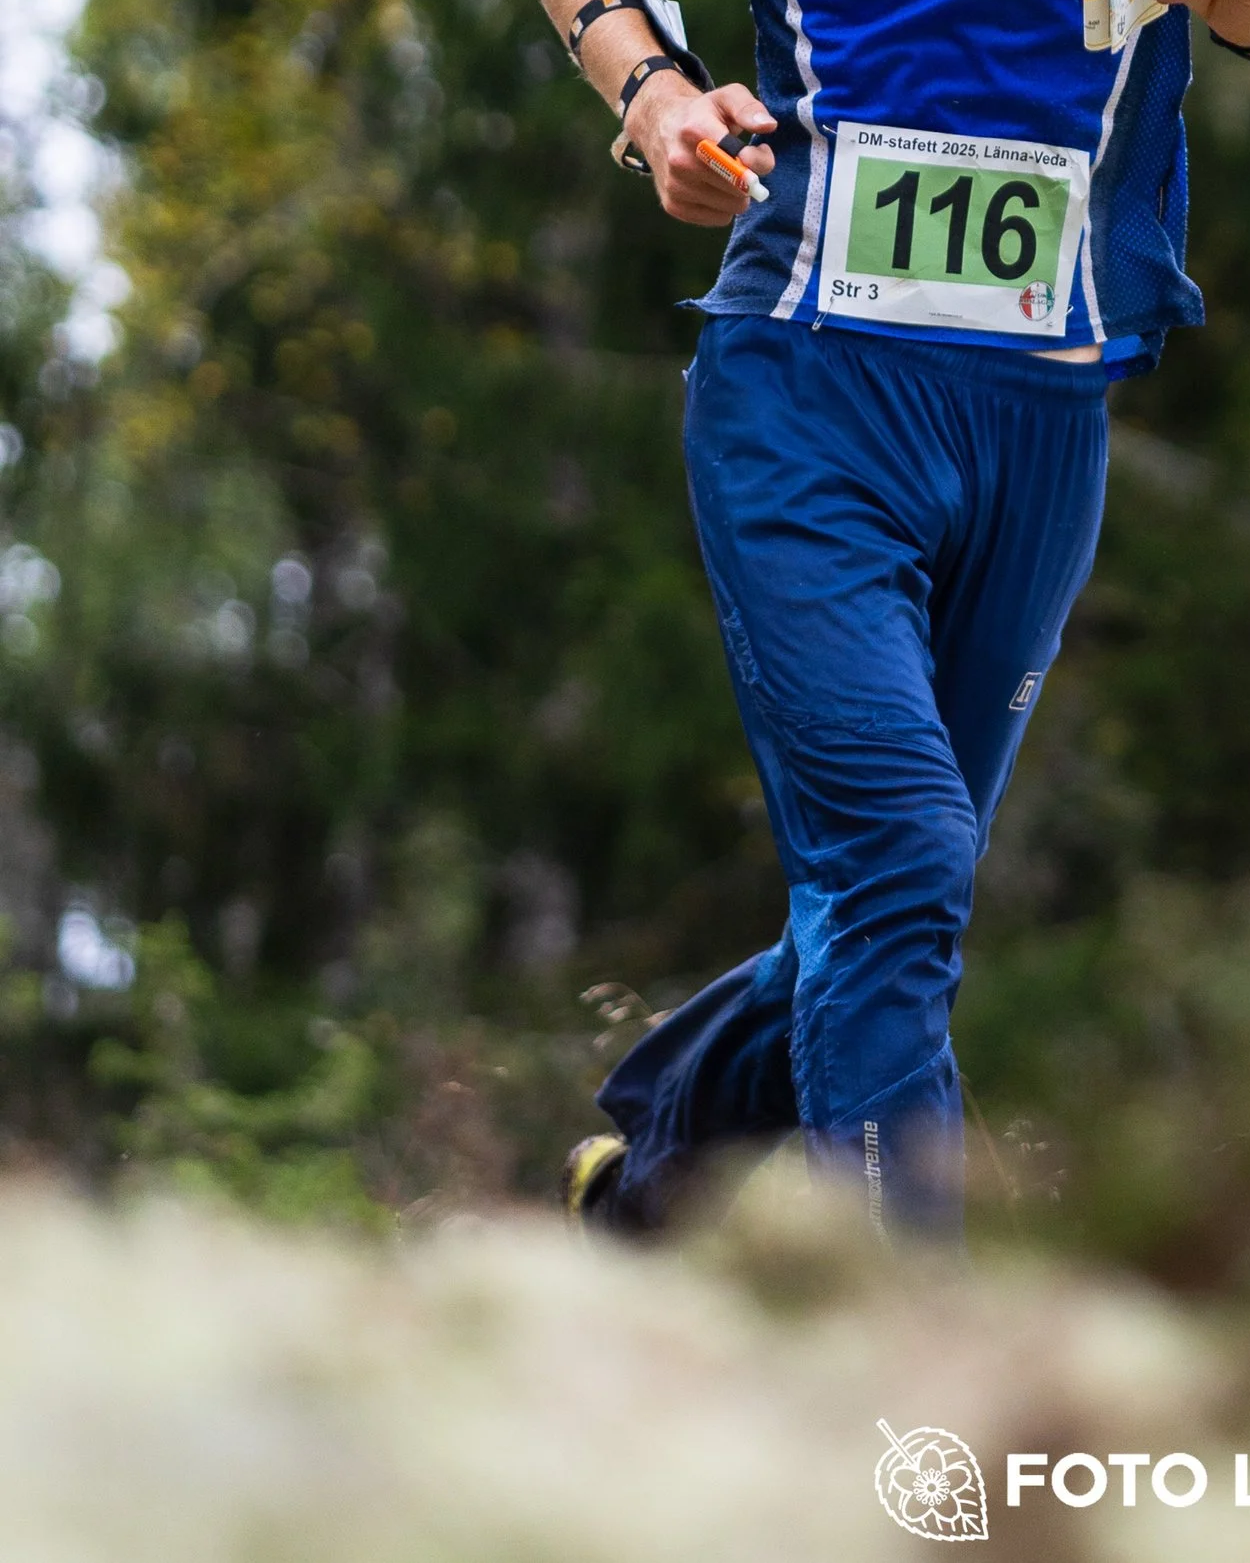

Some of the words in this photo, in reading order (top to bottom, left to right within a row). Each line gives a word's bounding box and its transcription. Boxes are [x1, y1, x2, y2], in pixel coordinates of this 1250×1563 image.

[858, 131, 937, 154] DM-stafett
[941, 141, 979, 159] 2025,
[984, 145, 1068, 168] Länna-Veda
[875, 170, 1040, 281] 116
[831, 279, 862, 299] Str
[868, 283, 880, 300] 3
